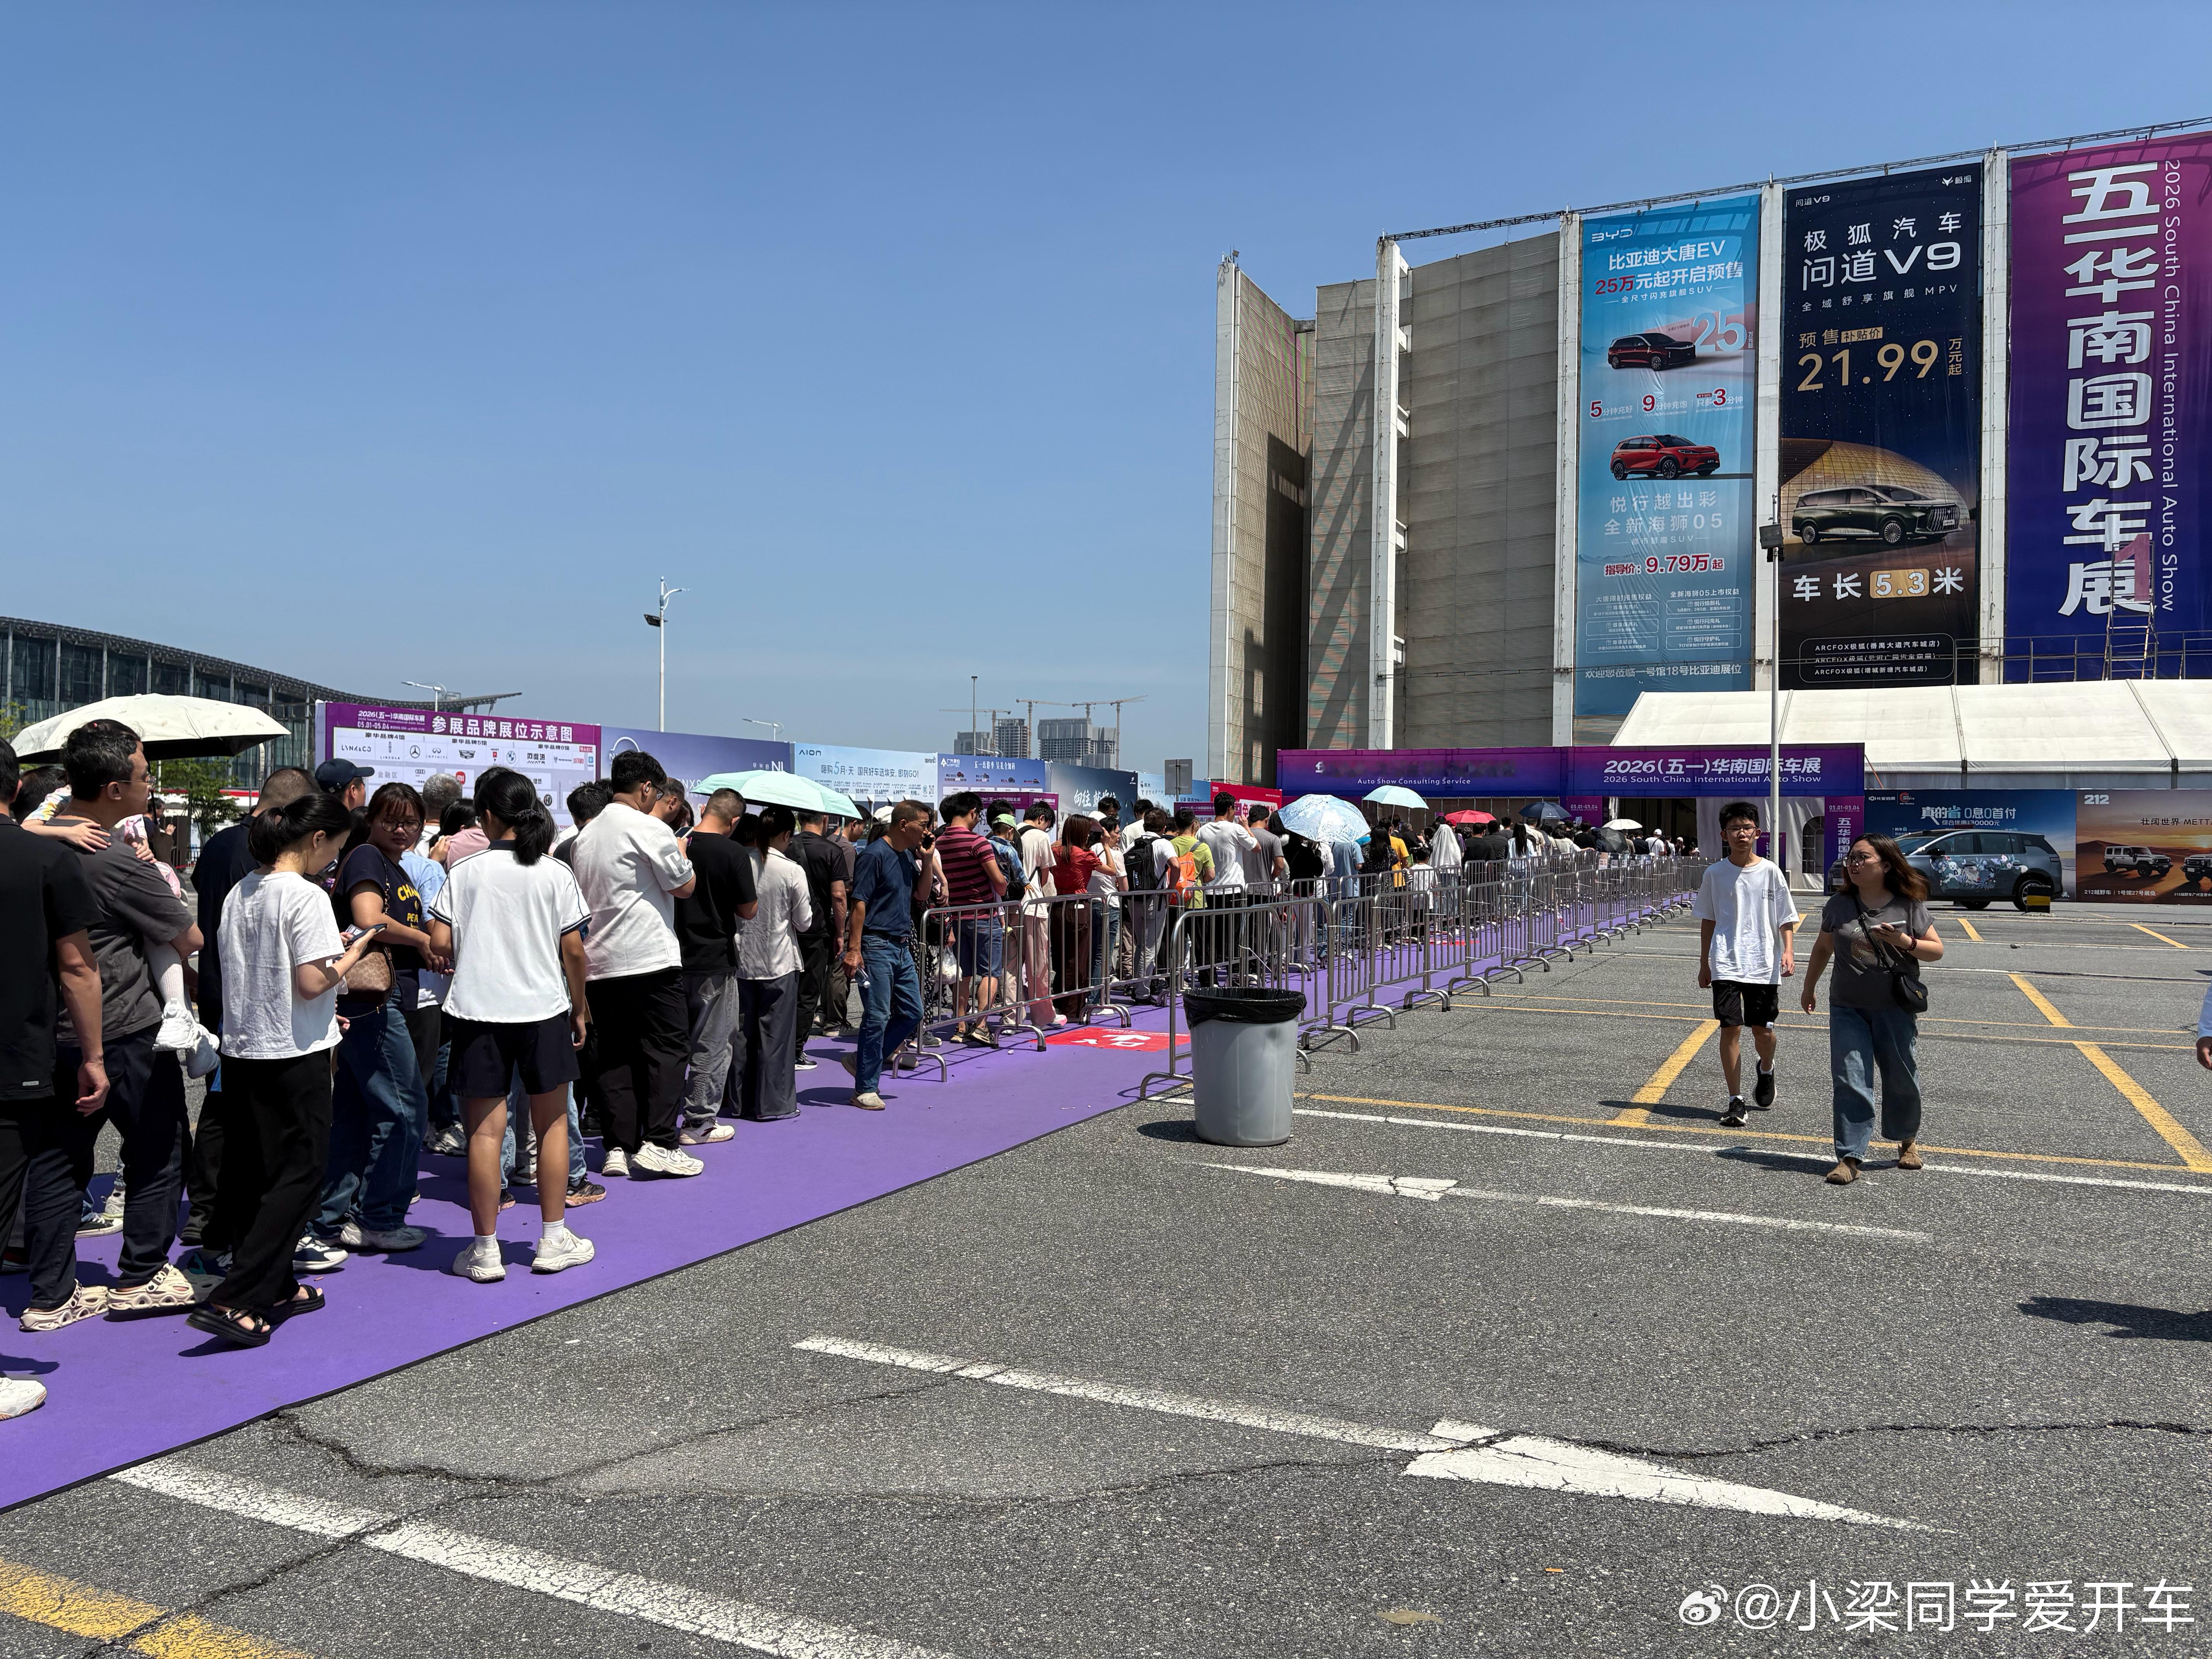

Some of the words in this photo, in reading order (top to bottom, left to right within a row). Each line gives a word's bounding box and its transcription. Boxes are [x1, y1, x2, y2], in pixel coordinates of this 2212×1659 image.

[1954, 175, 1972, 184] 极狐
[2165, 159, 2181, 210] 2026
[1795, 195, 1830, 207] 问道V9
[1592, 228, 1633, 243] BYD
[1803, 211, 1962, 252] 极狐汽车
[2165, 216, 2181, 277] South
[1608, 240, 1726, 271] 比亚迪大唐EV
[1802, 241, 1961, 291] 问道V9
[1595, 261, 1743, 295] 25万元起开启预售
[2164, 285, 2180, 344] China
[1692, 310, 1747, 352] 25
[1799, 328, 1839, 349] 预售
[1843, 327, 1881, 342] 补贴价
[1797, 339, 1939, 392] 21.99
[1948, 337, 1963, 376] 万元起
[2058, 161, 2160, 616] 五一华南国际车展
[2162, 353, 2179, 488] International
[1610, 490, 1717, 514] 悦行越出彩
[1604, 513, 1723, 536] 全新海狮05
[2162, 495, 2178, 547] Auto
[1670, 587, 1740, 598] 全新海狮05上市权益
[1793, 567, 1964, 602] 车长5.3米
[2161, 553, 2178, 611] Show
[1585, 664, 1742, 679] 欢迎您莅临一号馆18号比亚迪展位
[357, 721, 390, 730] 05.01-05.04
[432, 715, 572, 742] 参展品牌展位示意图
[1398, 778, 1440, 786] Consulting
[1920, 805, 1962, 825] 真的省
[1964, 807, 2017, 819] 0息0首付
[2084, 794, 2109, 805] 212
[2140, 817, 2180, 826] 壮阔世界
